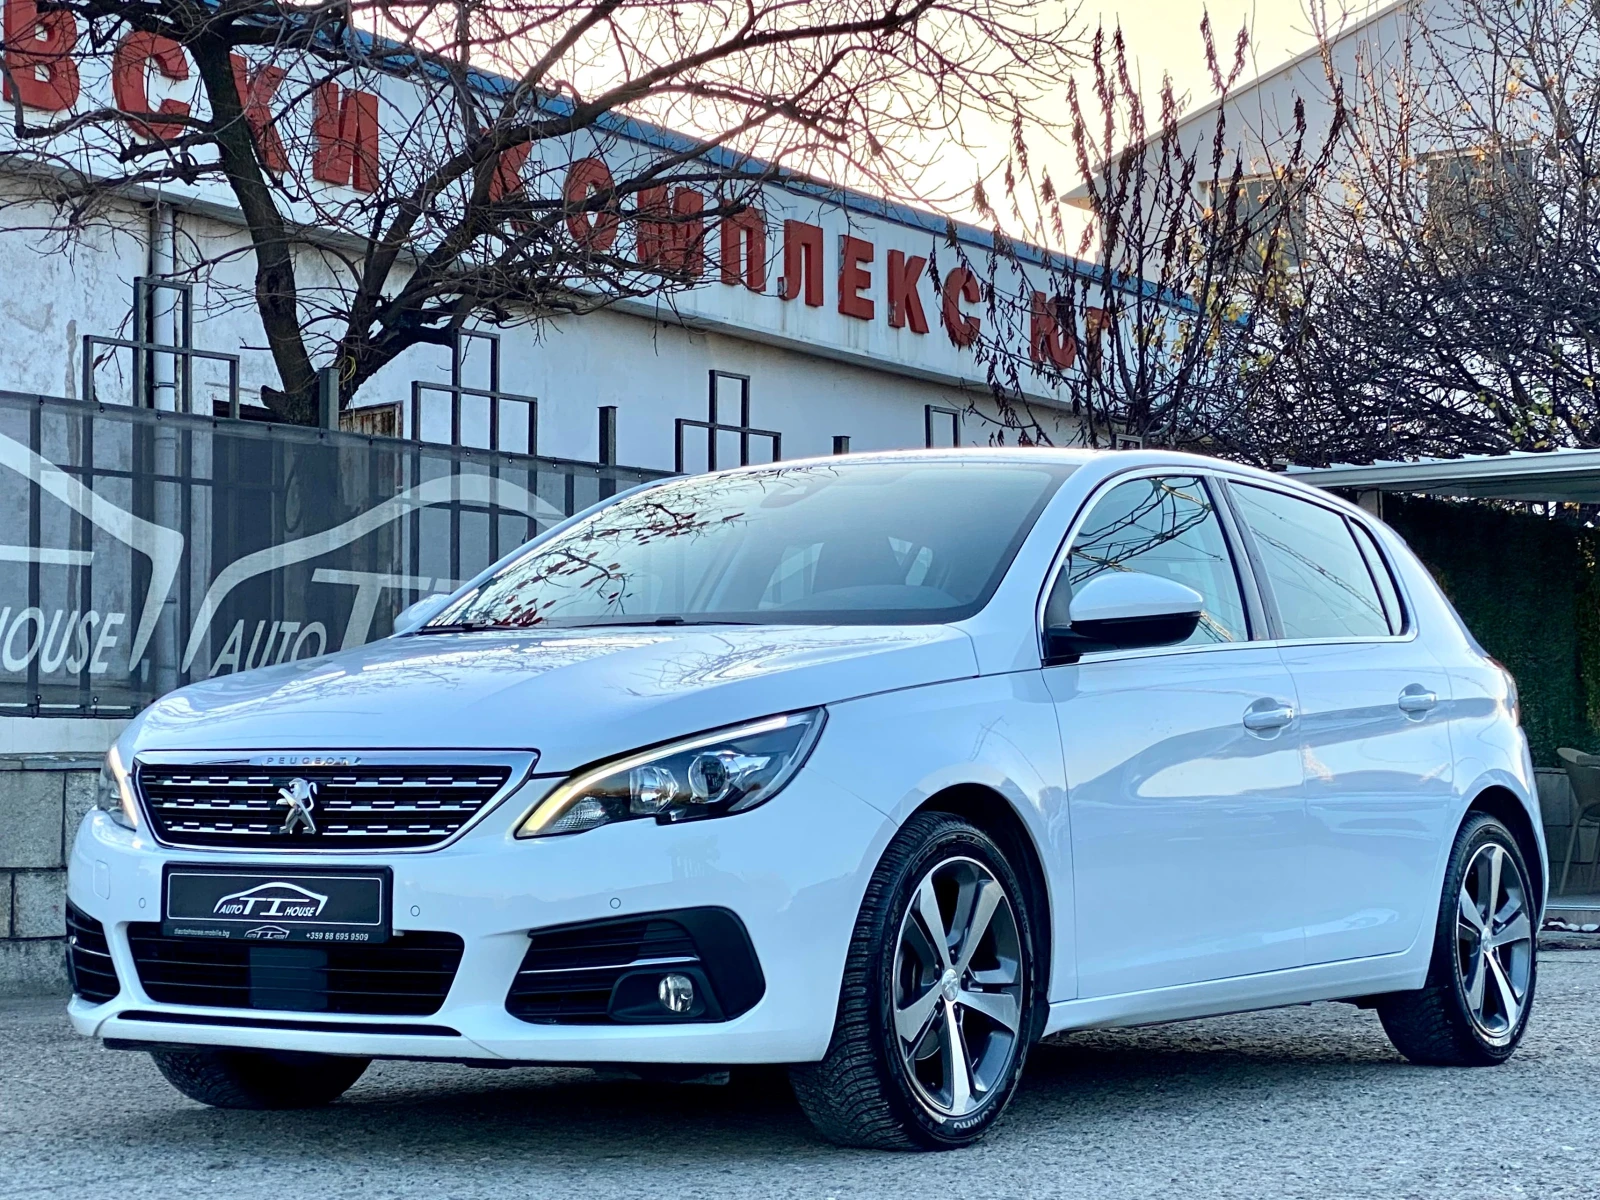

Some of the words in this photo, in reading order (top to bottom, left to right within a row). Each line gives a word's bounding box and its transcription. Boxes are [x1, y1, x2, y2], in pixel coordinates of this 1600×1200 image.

[208, 618, 328, 668] AUTO
[266, 756, 348, 765] PEUGEOT
[218, 904, 244, 915] AUTO
[283, 906, 317, 917] HOUSE
[305, 931, 324, 940] +359
[324, 932, 334, 941] 88
[335, 932, 350, 941] 695
[350, 933, 369, 941] 9509
